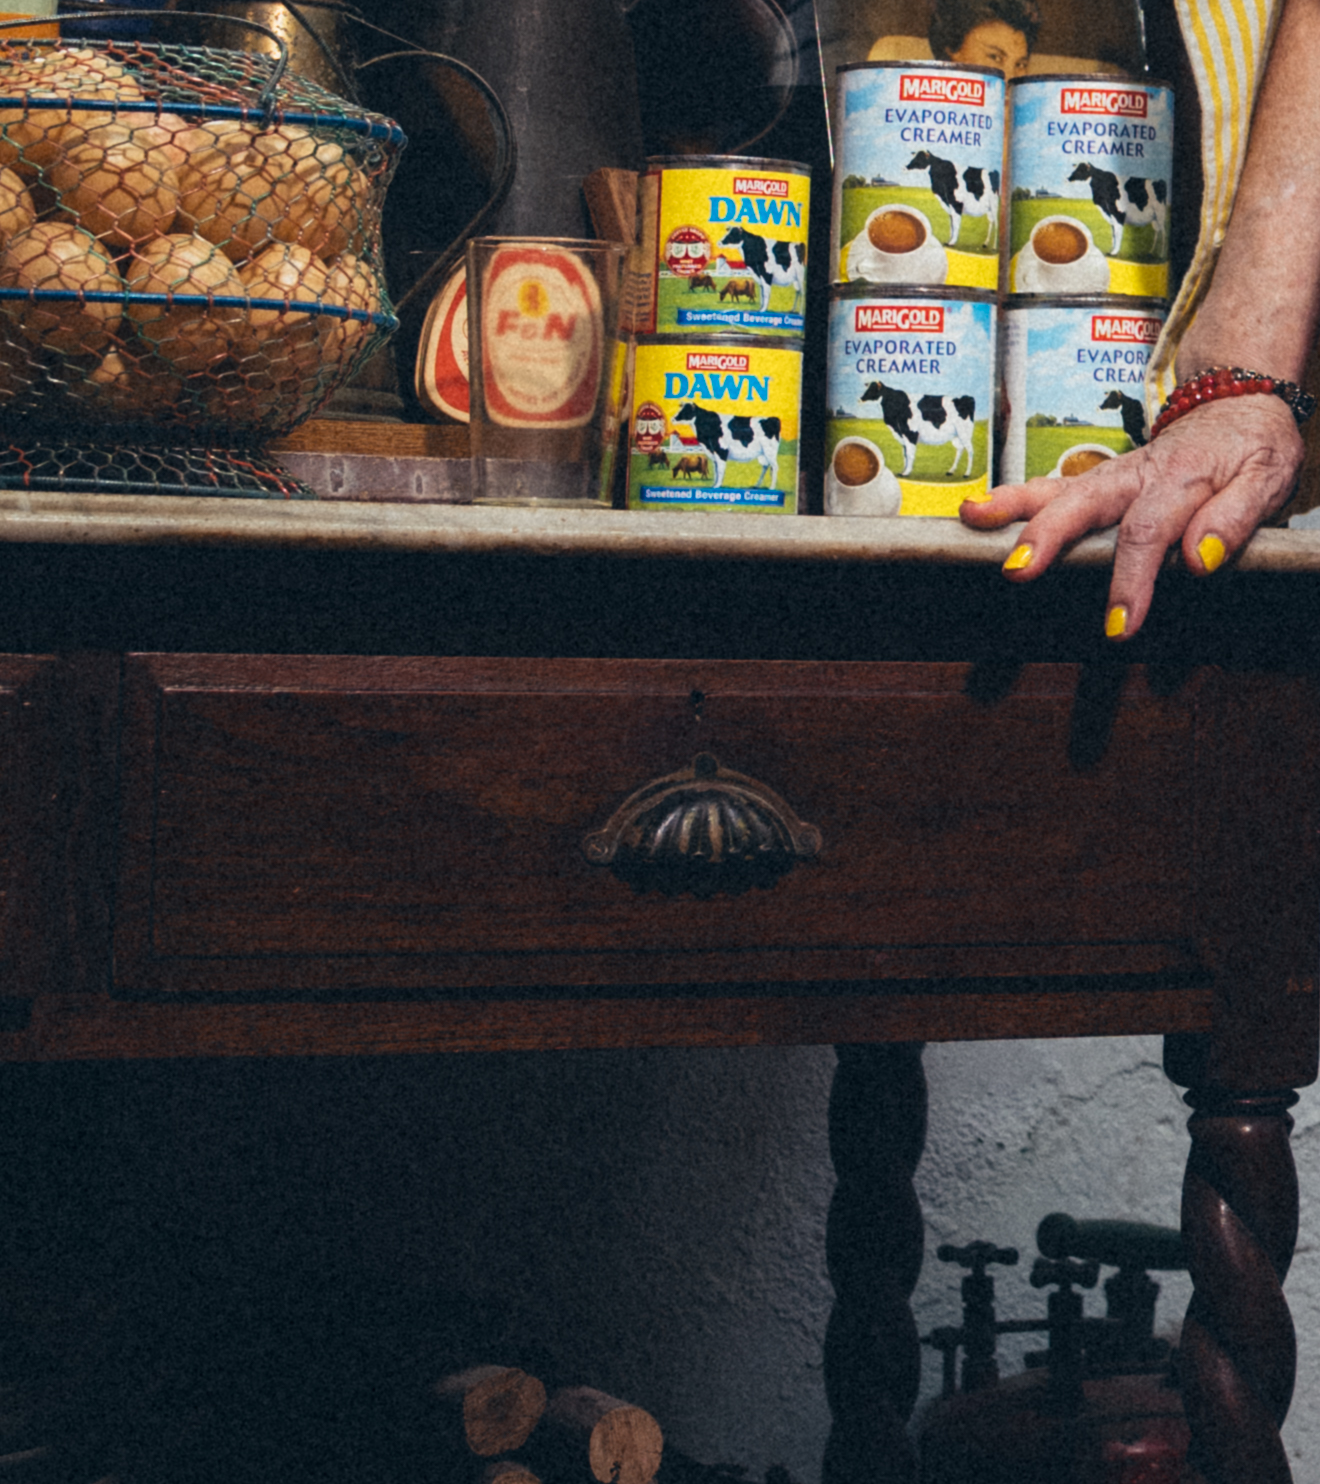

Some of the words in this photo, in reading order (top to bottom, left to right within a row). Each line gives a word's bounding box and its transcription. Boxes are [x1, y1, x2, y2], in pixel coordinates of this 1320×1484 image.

[902, 77, 983, 99] MARIGOLD
[1063, 91, 1145, 113] MARIGOLD
[884, 108, 993, 130] EVAPORATED
[900, 127, 983, 147] CREAMER
[1046, 121, 1157, 142] EVAPORATED
[1061, 140, 1146, 159] CREAMER
[735, 178, 788, 196] MARIGOLD
[708, 196, 803, 228] DAWN
[686, 311, 741, 323] Sweetened
[742, 312, 783, 325] Beverage
[857, 308, 941, 329] MARIGOLD
[844, 339, 957, 357] EVAPORATED
[688, 355, 748, 371] MARIGOLD
[855, 358, 941, 375] CREAMER
[663, 372, 771, 402] DAWN
[645, 488, 693, 500] Sweetened
[695, 489, 742, 503] Beverage
[743, 490, 780, 503] Creamer
